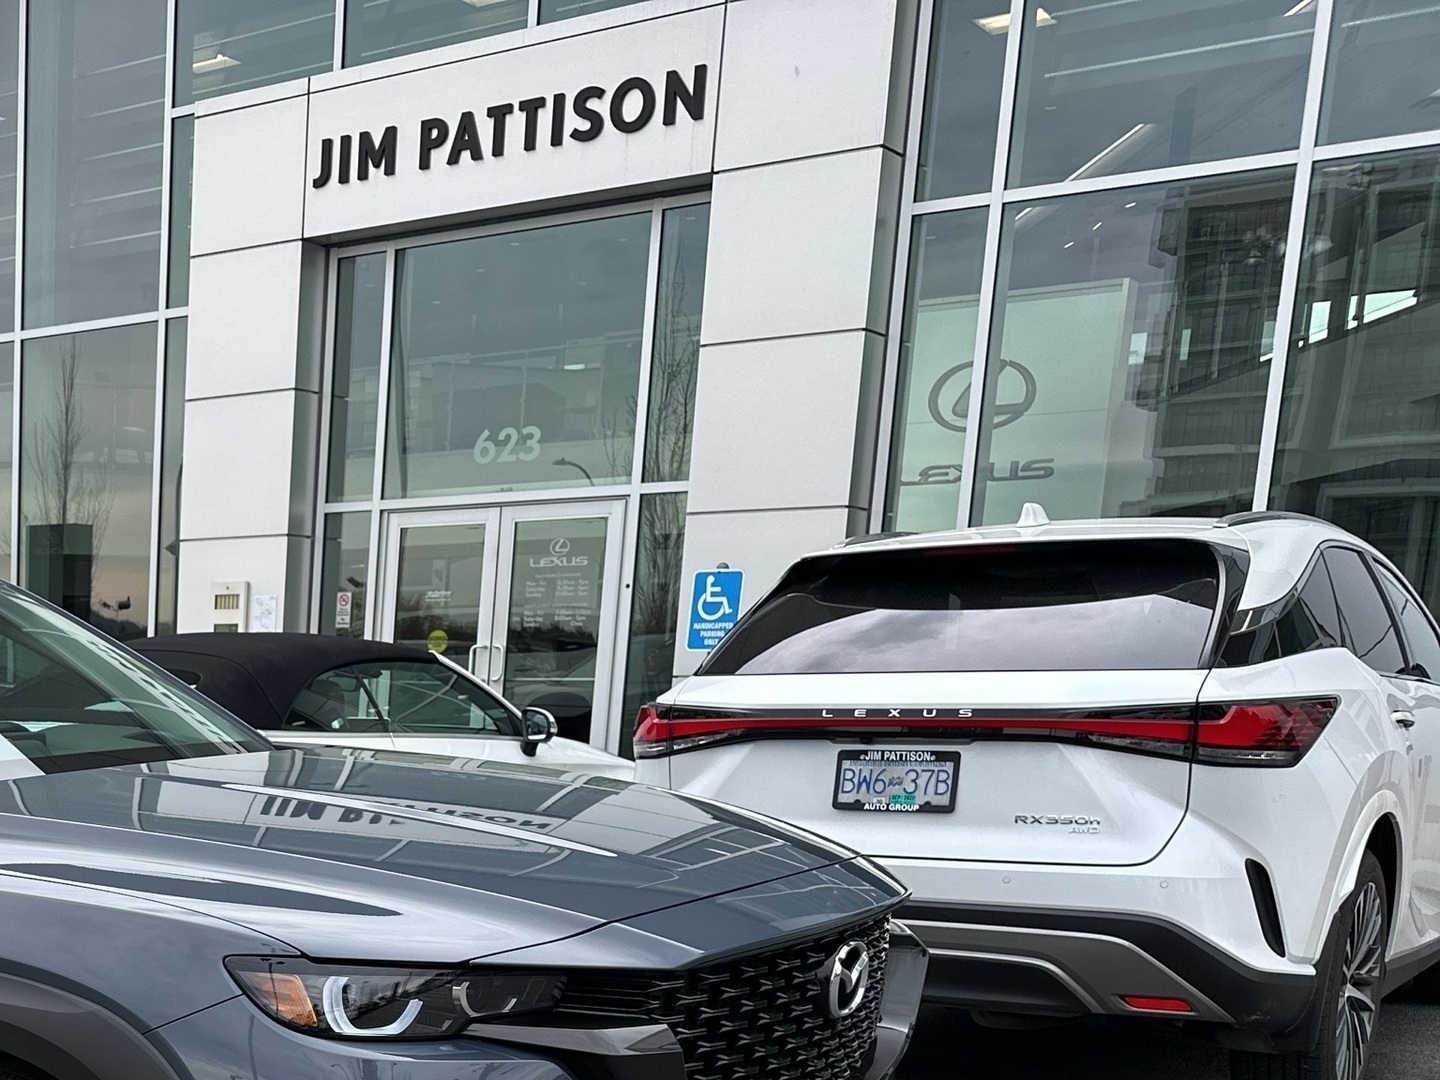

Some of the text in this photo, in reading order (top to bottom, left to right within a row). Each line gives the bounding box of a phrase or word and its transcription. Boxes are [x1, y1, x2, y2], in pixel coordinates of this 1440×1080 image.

[312, 63, 709, 189] JIM PATTISON
[473, 425, 541, 464] 623
[530, 556, 588, 567] LEXUS
[693, 622, 734, 630] HANDICAPPED
[700, 630, 725, 638] PARKING
[822, 709, 973, 718] LEXUS
[865, 751, 931, 761] JIM PATTISON
[841, 768, 950, 796] BW6 37B
[863, 803, 887, 811] AUTO
[888, 803, 920, 812] GROUP
[1014, 814, 1101, 826] RX350h
[1068, 827, 1100, 835] AWD
